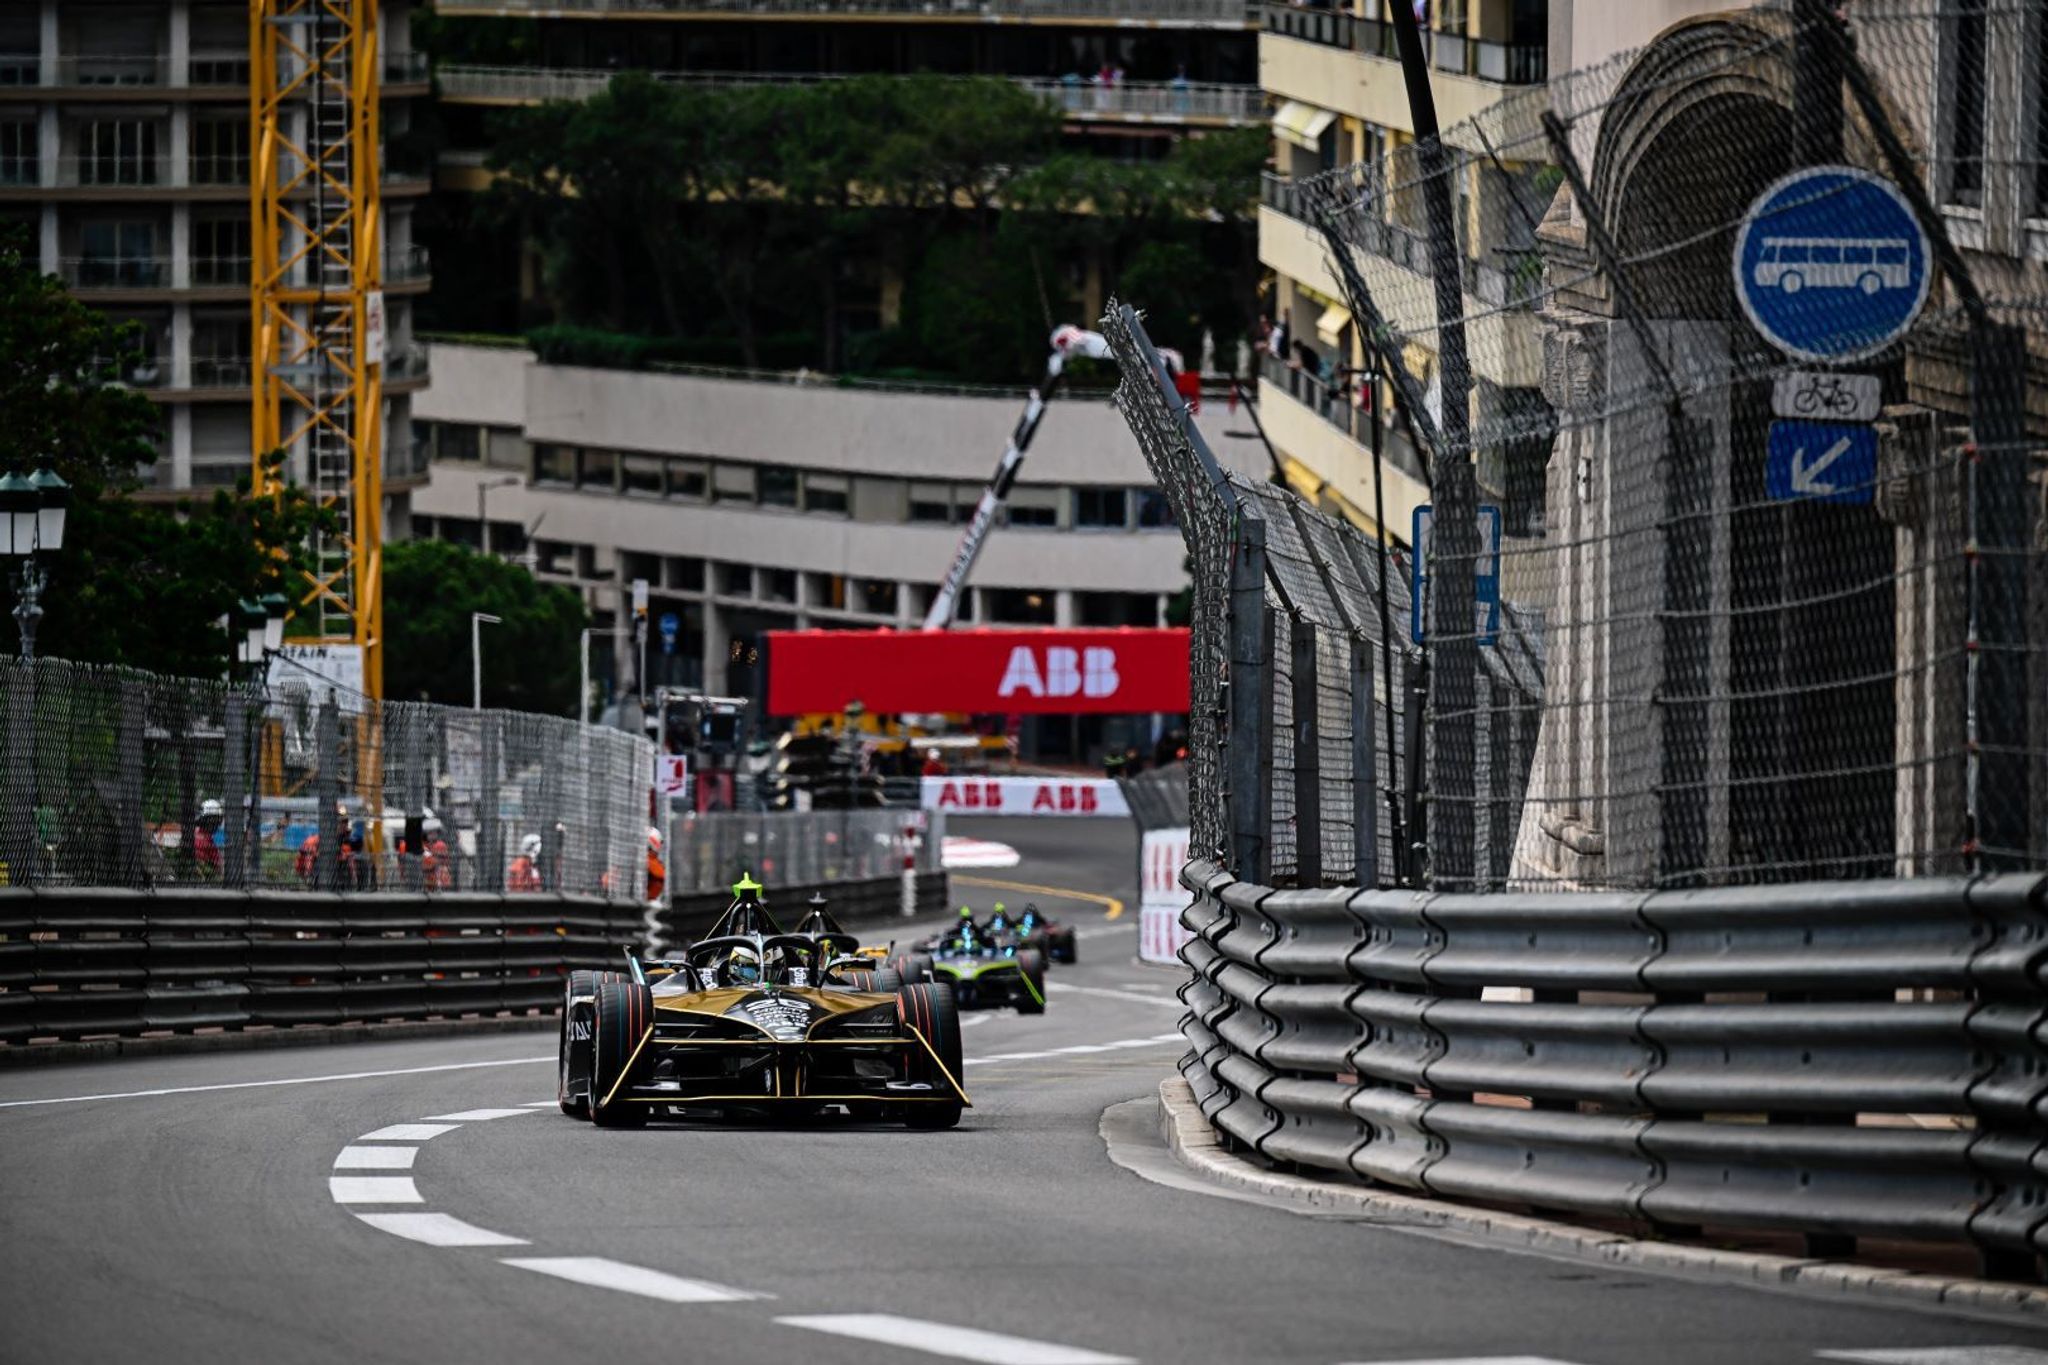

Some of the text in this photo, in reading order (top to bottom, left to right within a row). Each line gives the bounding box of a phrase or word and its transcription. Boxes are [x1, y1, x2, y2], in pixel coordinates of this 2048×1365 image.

[998, 646, 1120, 697] ABB
[939, 782, 1098, 812] ABB ABB
